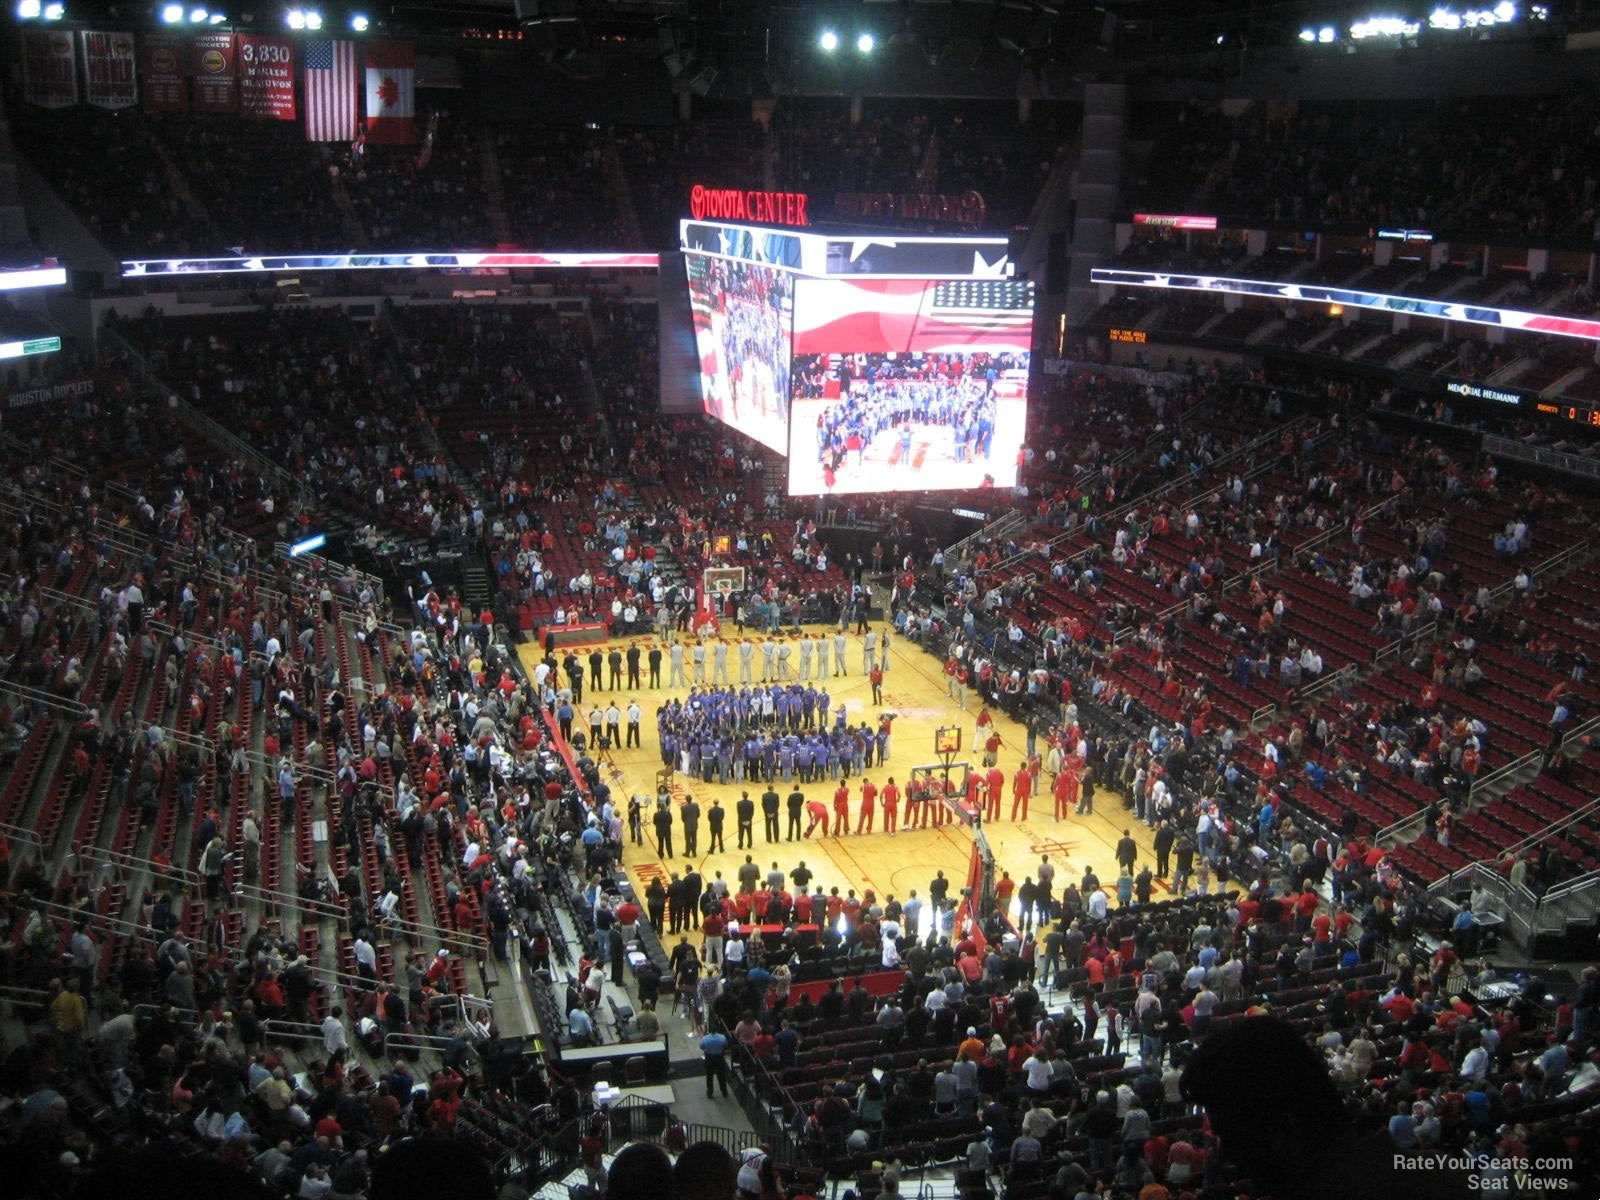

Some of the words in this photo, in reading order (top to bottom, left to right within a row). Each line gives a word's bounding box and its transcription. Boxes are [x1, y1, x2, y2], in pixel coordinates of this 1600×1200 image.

[704, 190, 743, 219] TOYOTA
[746, 191, 809, 226] CENTER
[1447, 383, 1481, 396] MEMORIAL
[1483, 389, 1520, 404] HERMANN
